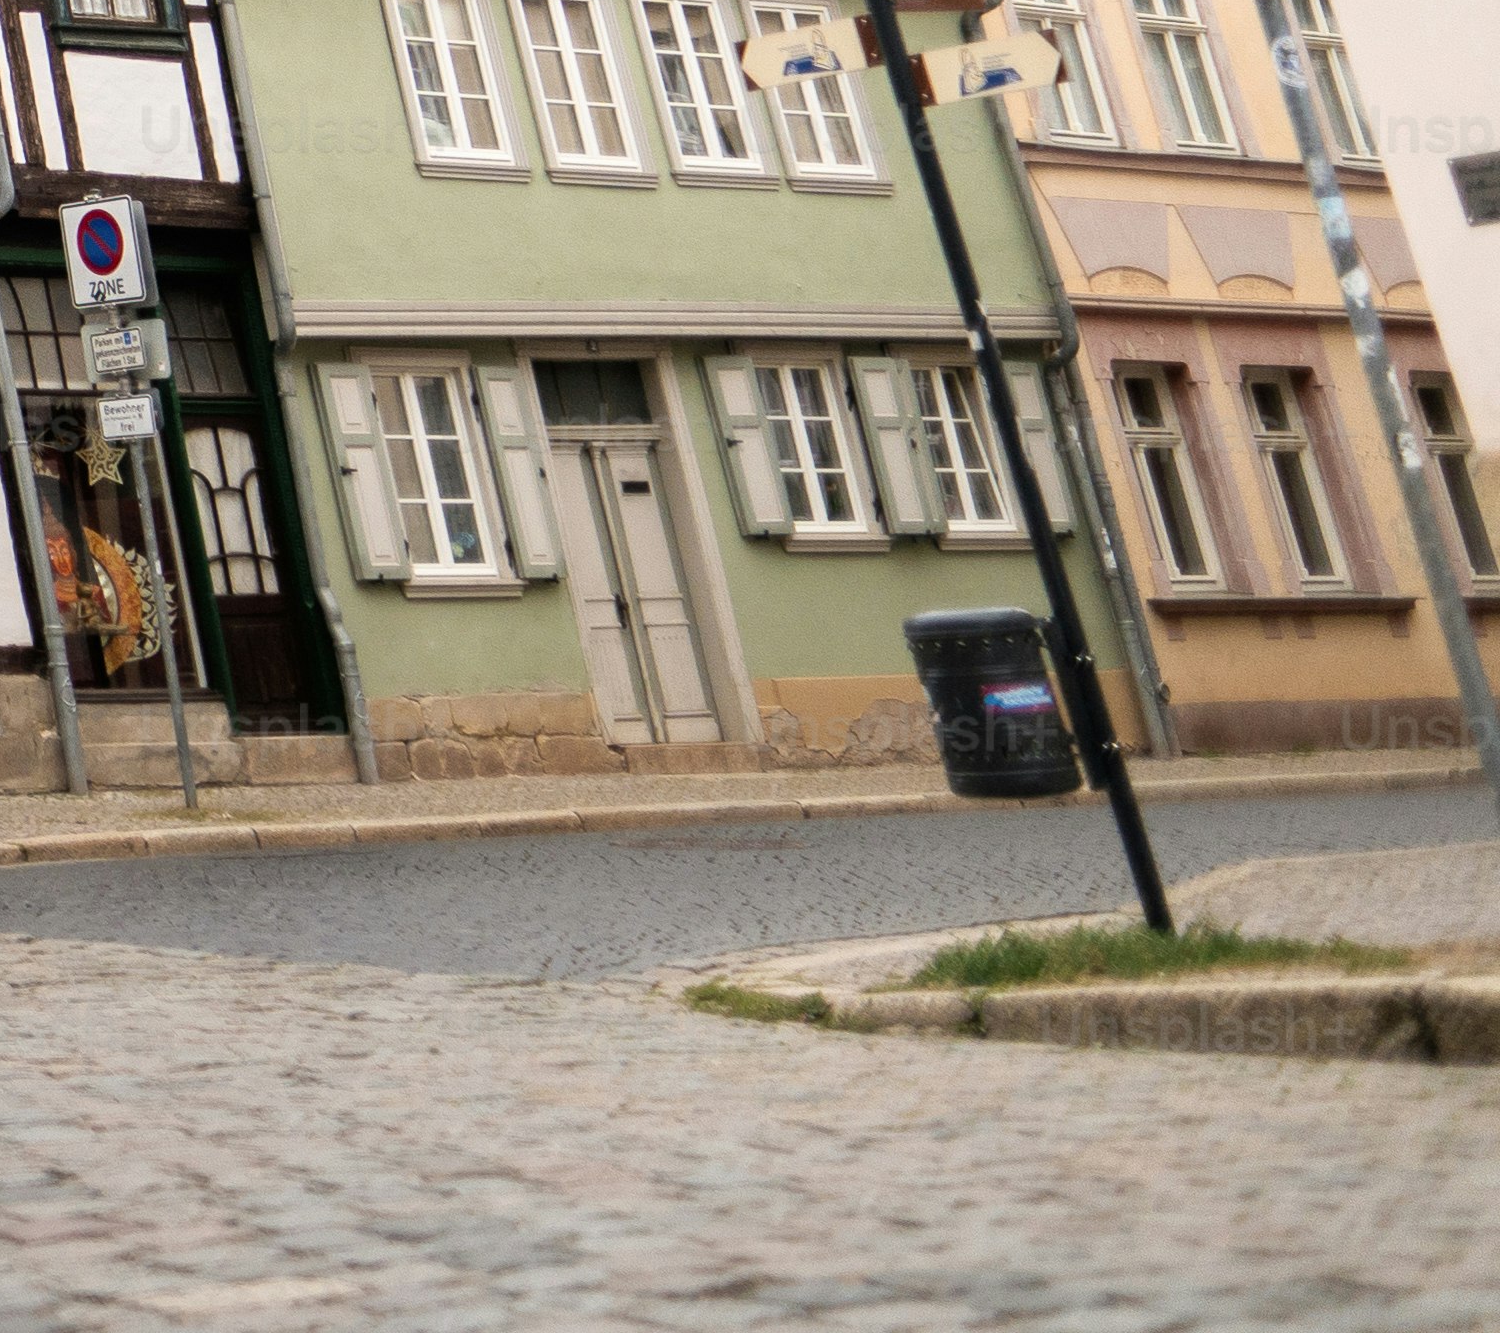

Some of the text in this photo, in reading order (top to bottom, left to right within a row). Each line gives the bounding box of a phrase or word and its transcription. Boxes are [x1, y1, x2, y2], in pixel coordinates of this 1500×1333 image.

[88, 278, 126, 299] ZONE
[94, 337, 113, 347] Parken
[104, 403, 145, 415] Bewohner
[120, 421, 136, 431] frei
